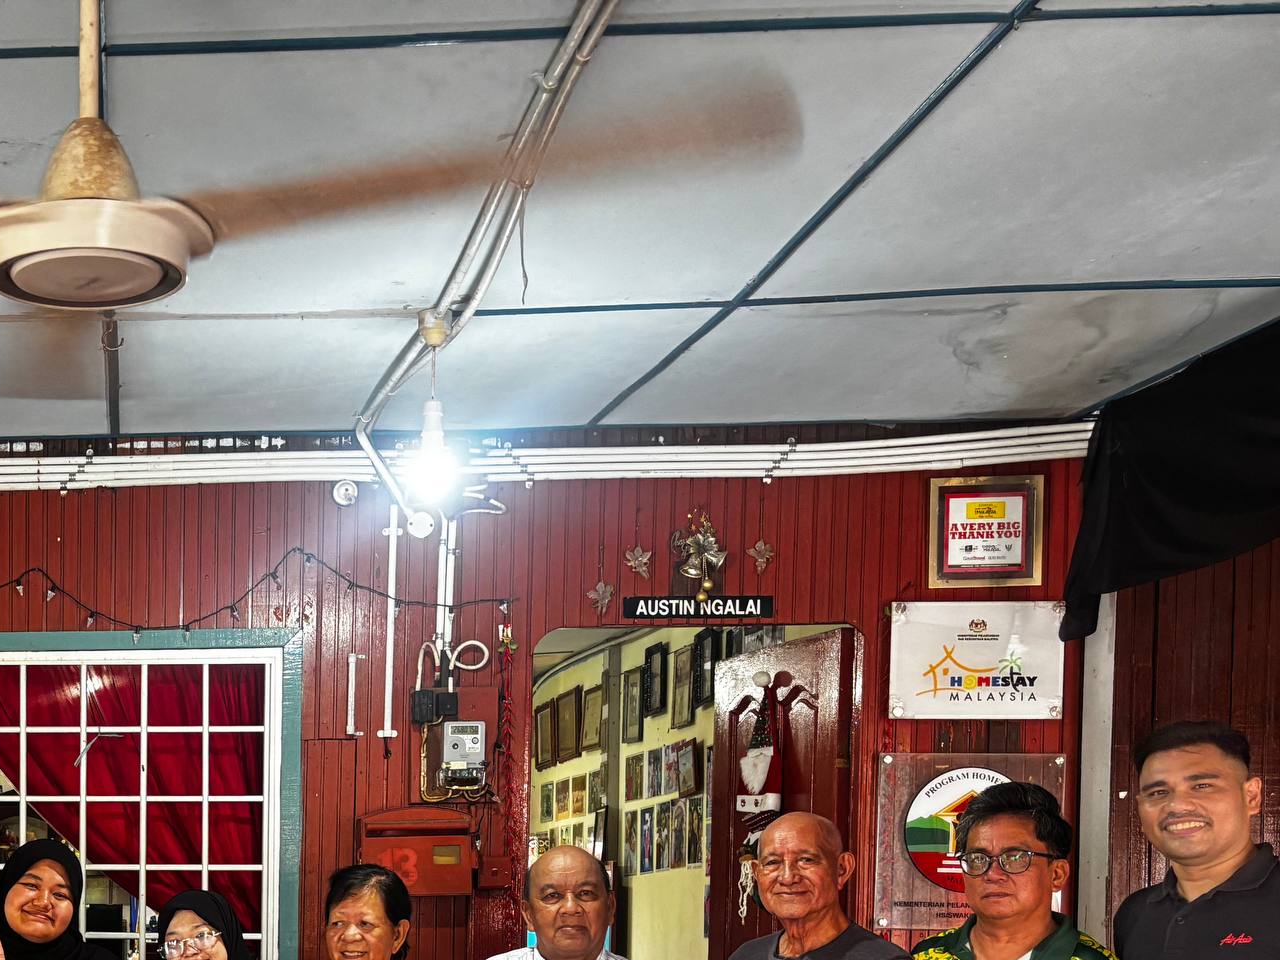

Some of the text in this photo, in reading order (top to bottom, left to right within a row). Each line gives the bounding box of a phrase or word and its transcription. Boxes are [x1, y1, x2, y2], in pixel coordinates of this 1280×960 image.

[950, 522, 1020, 531] A VERY BIG
[950, 530, 1021, 540] THANK YOU
[636, 599, 761, 616] AUSTIN NGALAI
[950, 668, 1038, 691] HOMESTAY
[949, 692, 1037, 701] MALAYSIA
[925, 772, 969, 798] PROGRAM
[378, 847, 418, 885] 13
